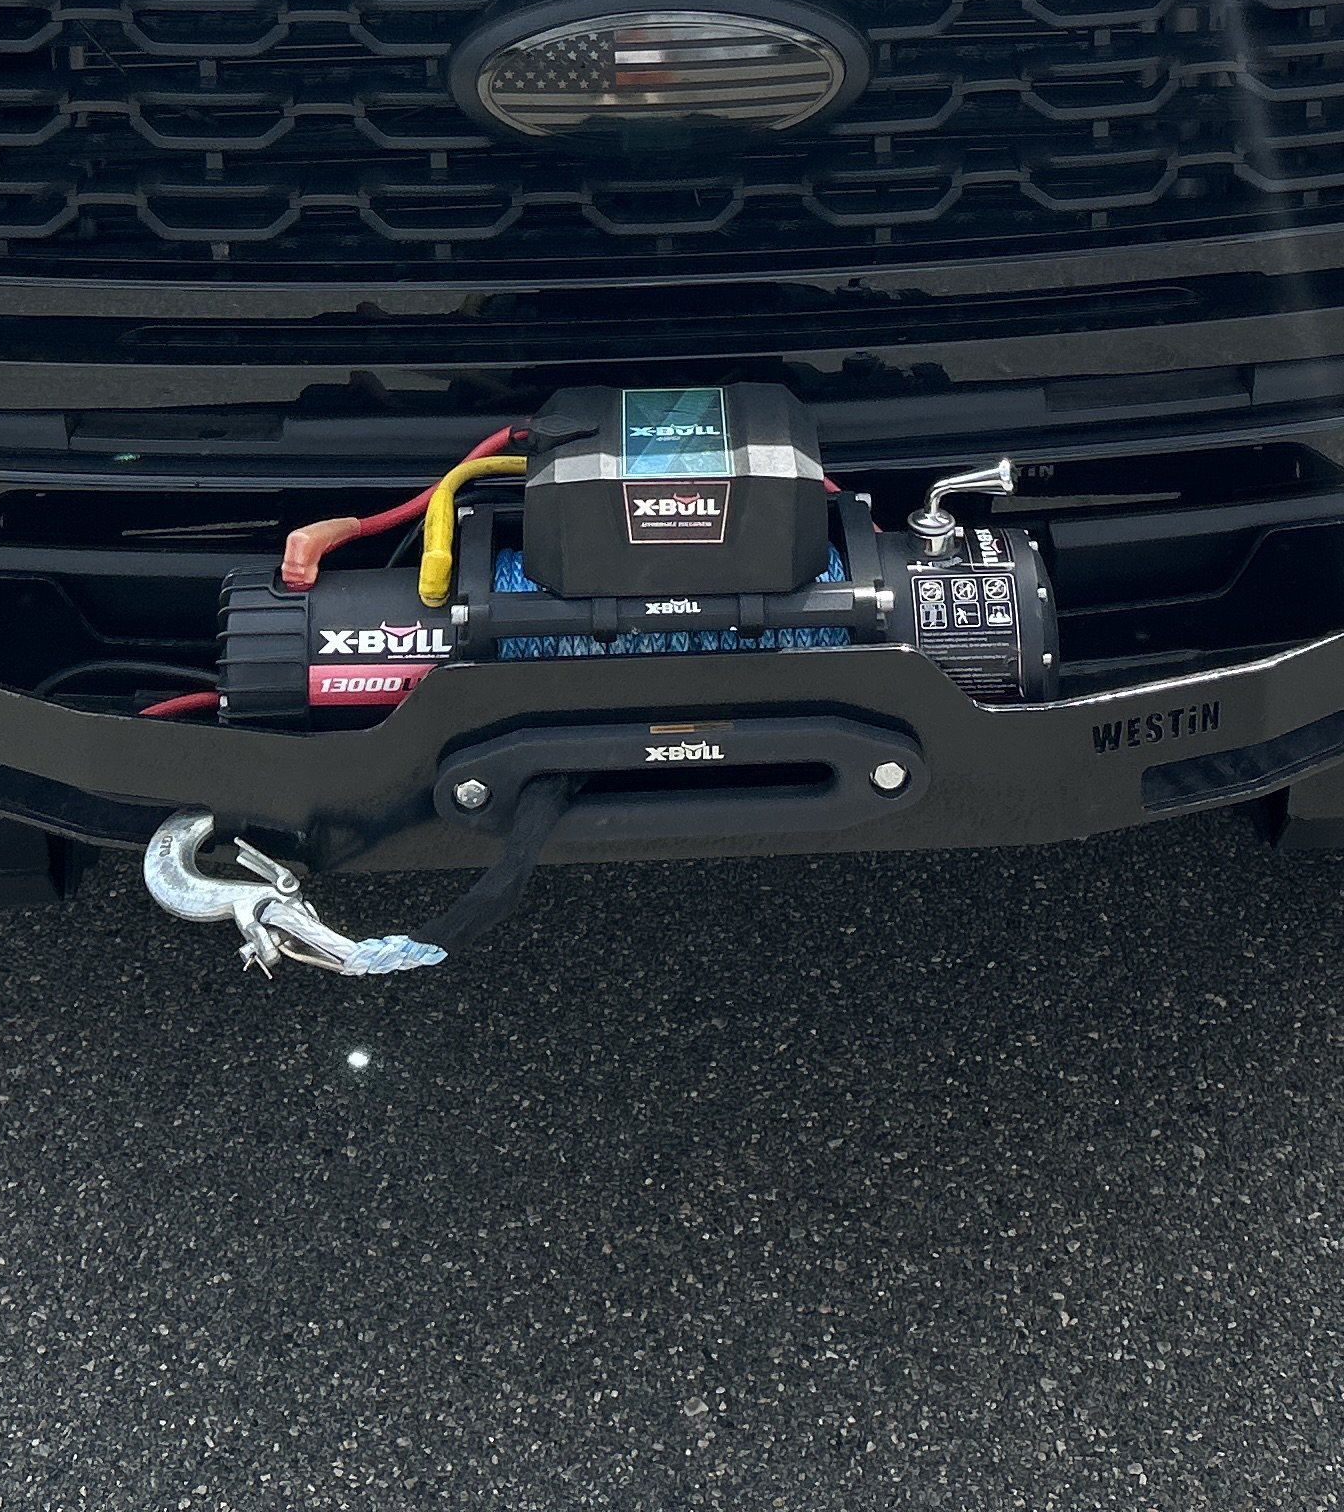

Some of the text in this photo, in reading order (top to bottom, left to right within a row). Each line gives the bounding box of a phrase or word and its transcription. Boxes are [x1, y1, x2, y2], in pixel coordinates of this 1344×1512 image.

[629, 424, 721, 437] X-BULL
[632, 495, 721, 516] X-BULL
[645, 599, 702, 615] X-BULL
[318, 624, 453, 654] X-BULL
[645, 742, 725, 761] X-BULL
